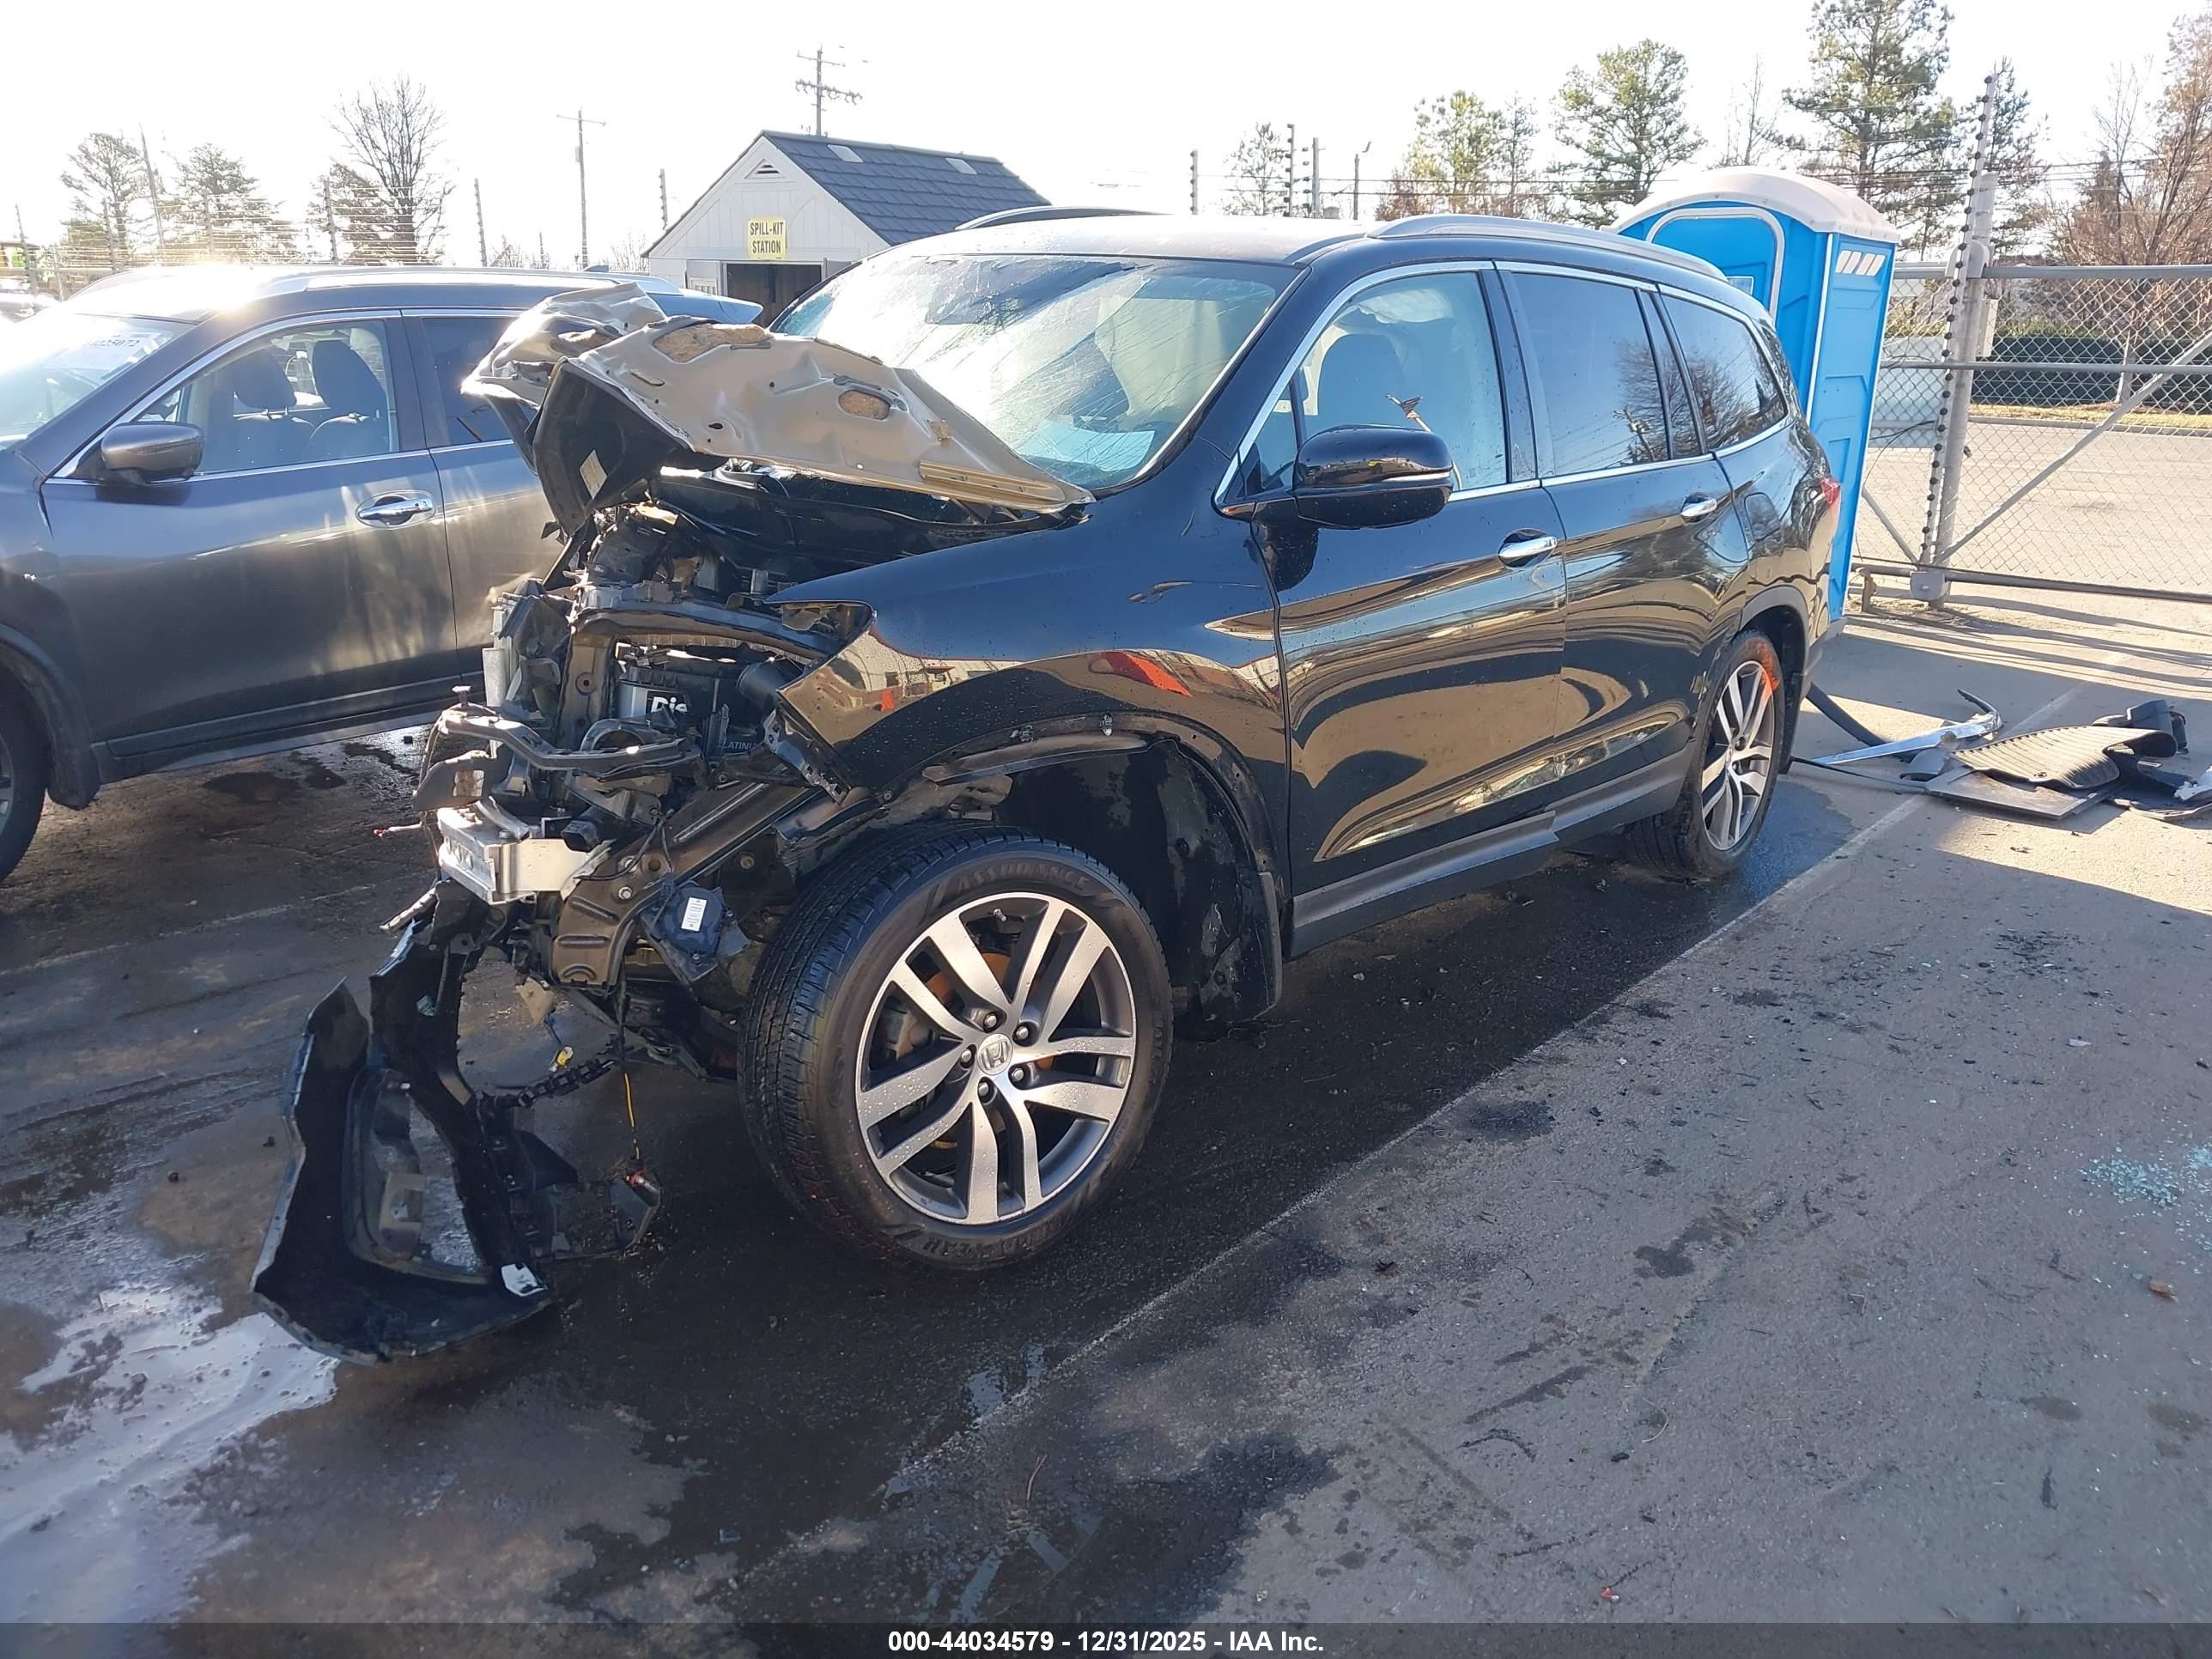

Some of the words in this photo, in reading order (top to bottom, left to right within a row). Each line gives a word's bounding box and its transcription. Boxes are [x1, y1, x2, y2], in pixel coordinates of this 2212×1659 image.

[750, 222, 784, 235] SPILL-KIT
[752, 240, 781, 254] STATION
[957, 861, 1090, 893] ASSURANCE
